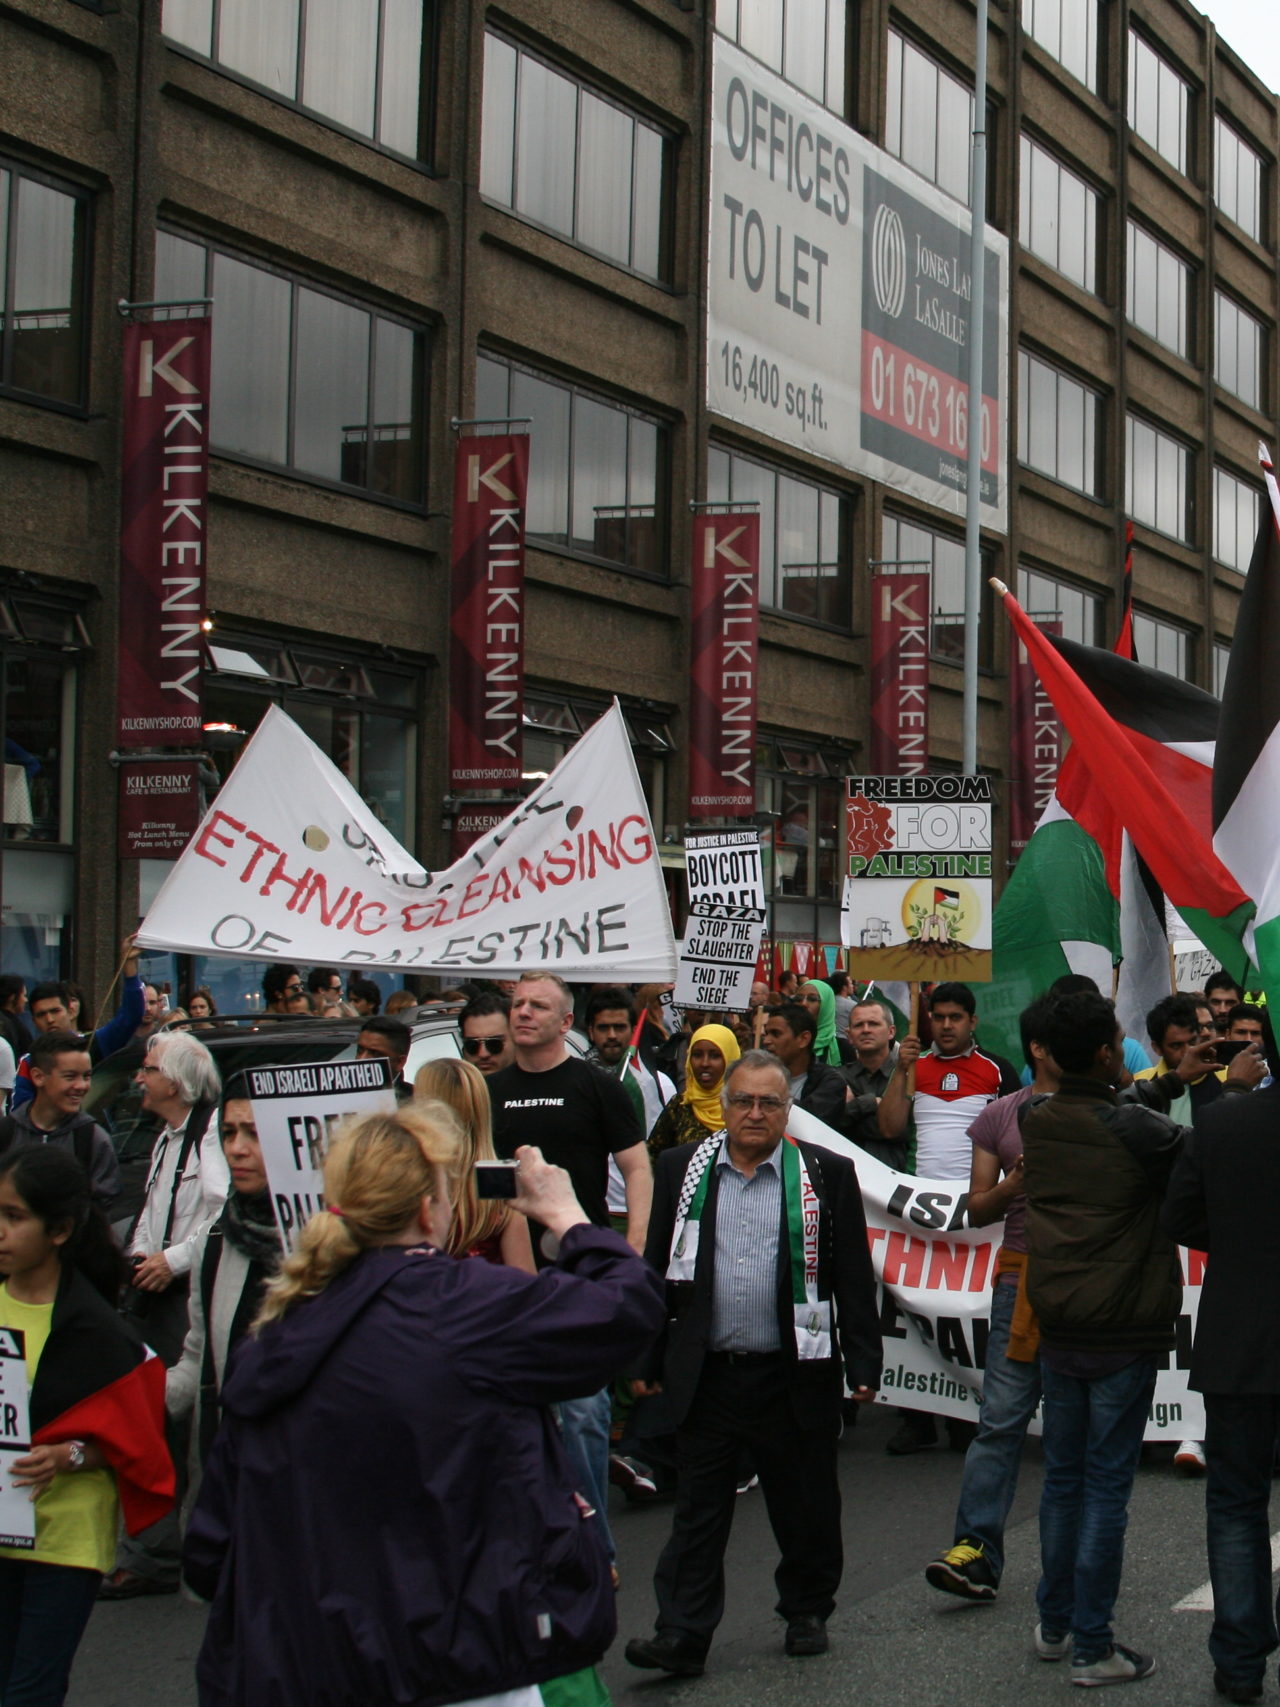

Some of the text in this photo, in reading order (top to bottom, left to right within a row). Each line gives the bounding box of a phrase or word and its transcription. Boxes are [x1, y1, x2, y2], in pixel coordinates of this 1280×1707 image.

[727, 77, 850, 225] OFFICES
[724, 193, 828, 325] TO LET
[915, 233, 949, 289] JONES
[722, 341, 828, 432] 16,400 sq.ft.
[871, 345, 990, 463] 01 673 160
[161, 402, 202, 703] KILKENNY
[485, 508, 520, 758] KILKENNY
[721, 573, 753, 787] KILKENNY
[898, 625, 925, 776] KILKENN
[121, 716, 202, 731] KILKENNYSHOP.COM
[127, 774, 192, 789] KILKENNY
[452, 767, 519, 780] KILKENNYSHOP.COM
[849, 775, 991, 801] FREEDOM
[685, 831, 758, 849] FOR JUSTICE IN PALESTINE
[896, 805, 992, 850] FOR
[194, 809, 388, 936] ETHNIC
[402, 814, 654, 933] CLEANSING
[687, 850, 759, 888] BOYCOTT
[849, 854, 992, 877] PALESTINE
[692, 903, 762, 921] GAZA
[698, 920, 752, 940] STOP THE
[338, 903, 630, 966] ESTINE
[688, 938, 754, 960] SLAUGHTER
[692, 967, 740, 987] END THE
[696, 986, 729, 1005] SIEGE
[252, 1062, 384, 1095] END ISRAELI APARTHEID
[504, 1097, 564, 1109] PALESTINE
[803, 1169, 818, 1286] ALESTINE
[882, 1365, 968, 1402] alestine
